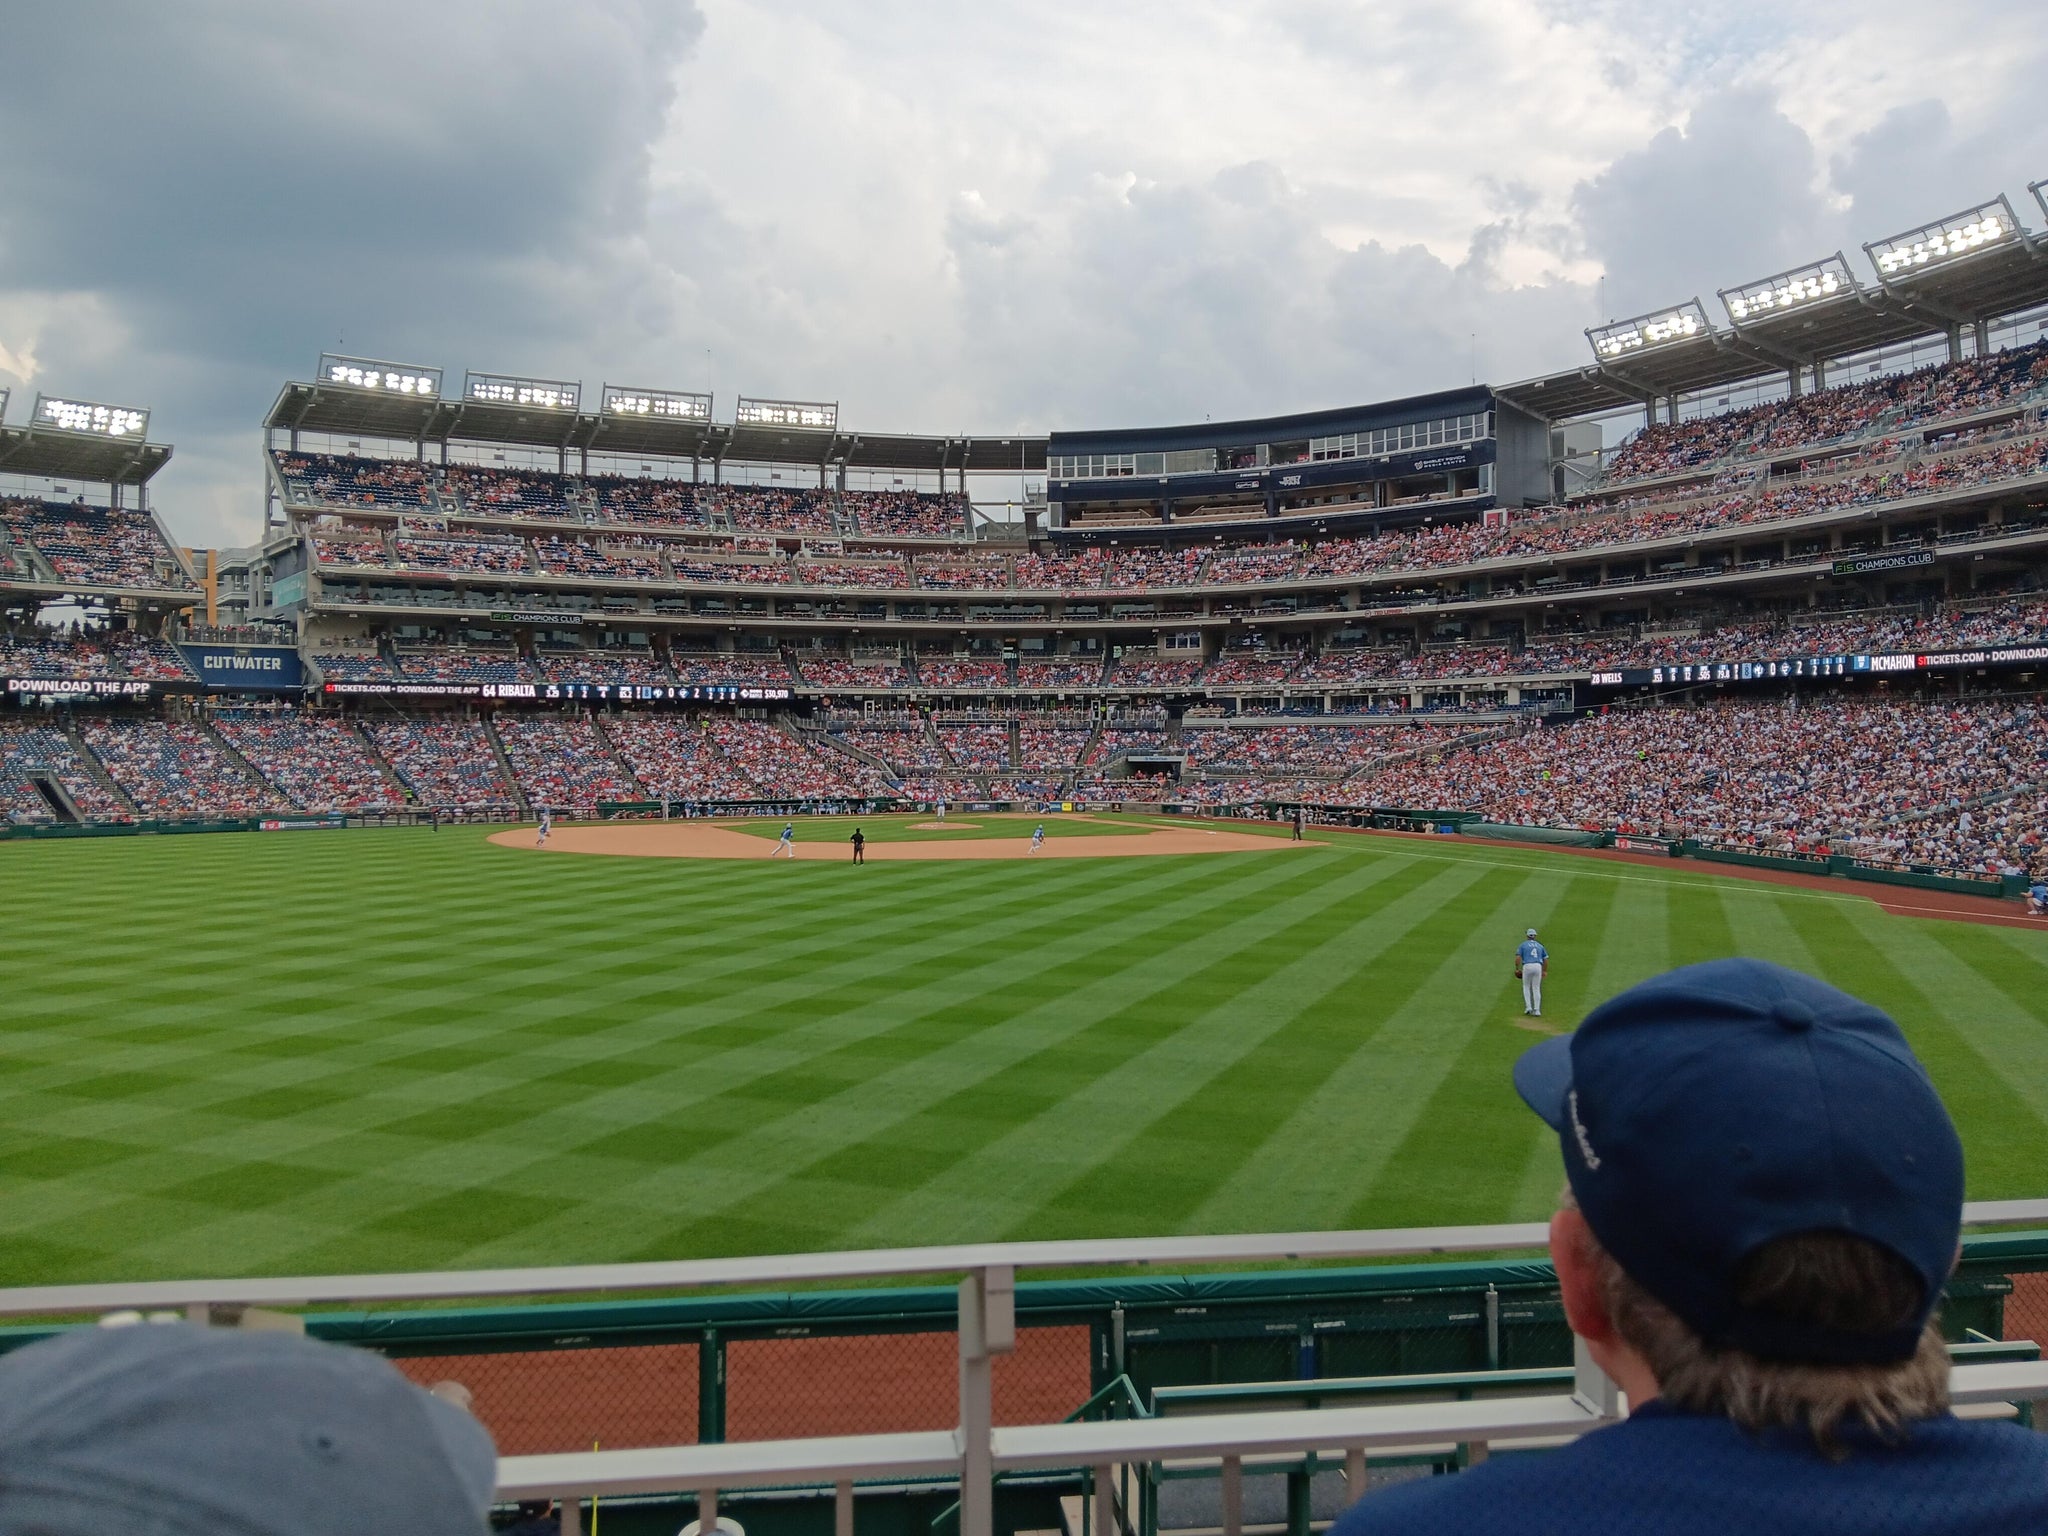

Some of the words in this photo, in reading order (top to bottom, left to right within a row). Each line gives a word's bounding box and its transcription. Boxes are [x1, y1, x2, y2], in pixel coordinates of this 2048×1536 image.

[1856, 557, 1905, 571] CHAMPIONS
[1907, 553, 1931, 564] CLUB
[513, 614, 559, 622] CHAMPIONS
[1871, 655, 1915, 670] MCMAHON
[1917, 652, 1984, 666] SITICKETS.COM
[1991, 648, 2048, 661] DOWNLOAD
[203, 656, 281, 670] CUTWATER
[1769, 662, 1776, 675] 0
[1796, 660, 1803, 674] 2
[1812, 665, 1818, 675] 2
[1825, 664, 1831, 674] 2
[1837, 664, 1843, 674] 0
[1591, 674, 1600, 684] 28
[1601, 673, 1622, 683] WELLS
[1684, 672, 1691, 681] 12
[8, 680, 91, 692] DOWNLOAD
[93, 681, 120, 692] THE
[122, 683, 150, 693] APP
[325, 684, 391, 693] SITICKETS.COM
[396, 685, 446, 693] DOWNLOAD
[447, 686, 462, 694] THE
[482, 685, 496, 697] 64
[498, 685, 536, 697] RIBALTA
[567, 690, 573, 698] 2
[581, 690, 587, 698] 2
[668, 688, 675, 697] 0
[693, 688, 700, 698] 2
[708, 691, 713, 699] 2
[764, 689, 788, 699] $30,970
[1530, 947, 1538, 958] 4
